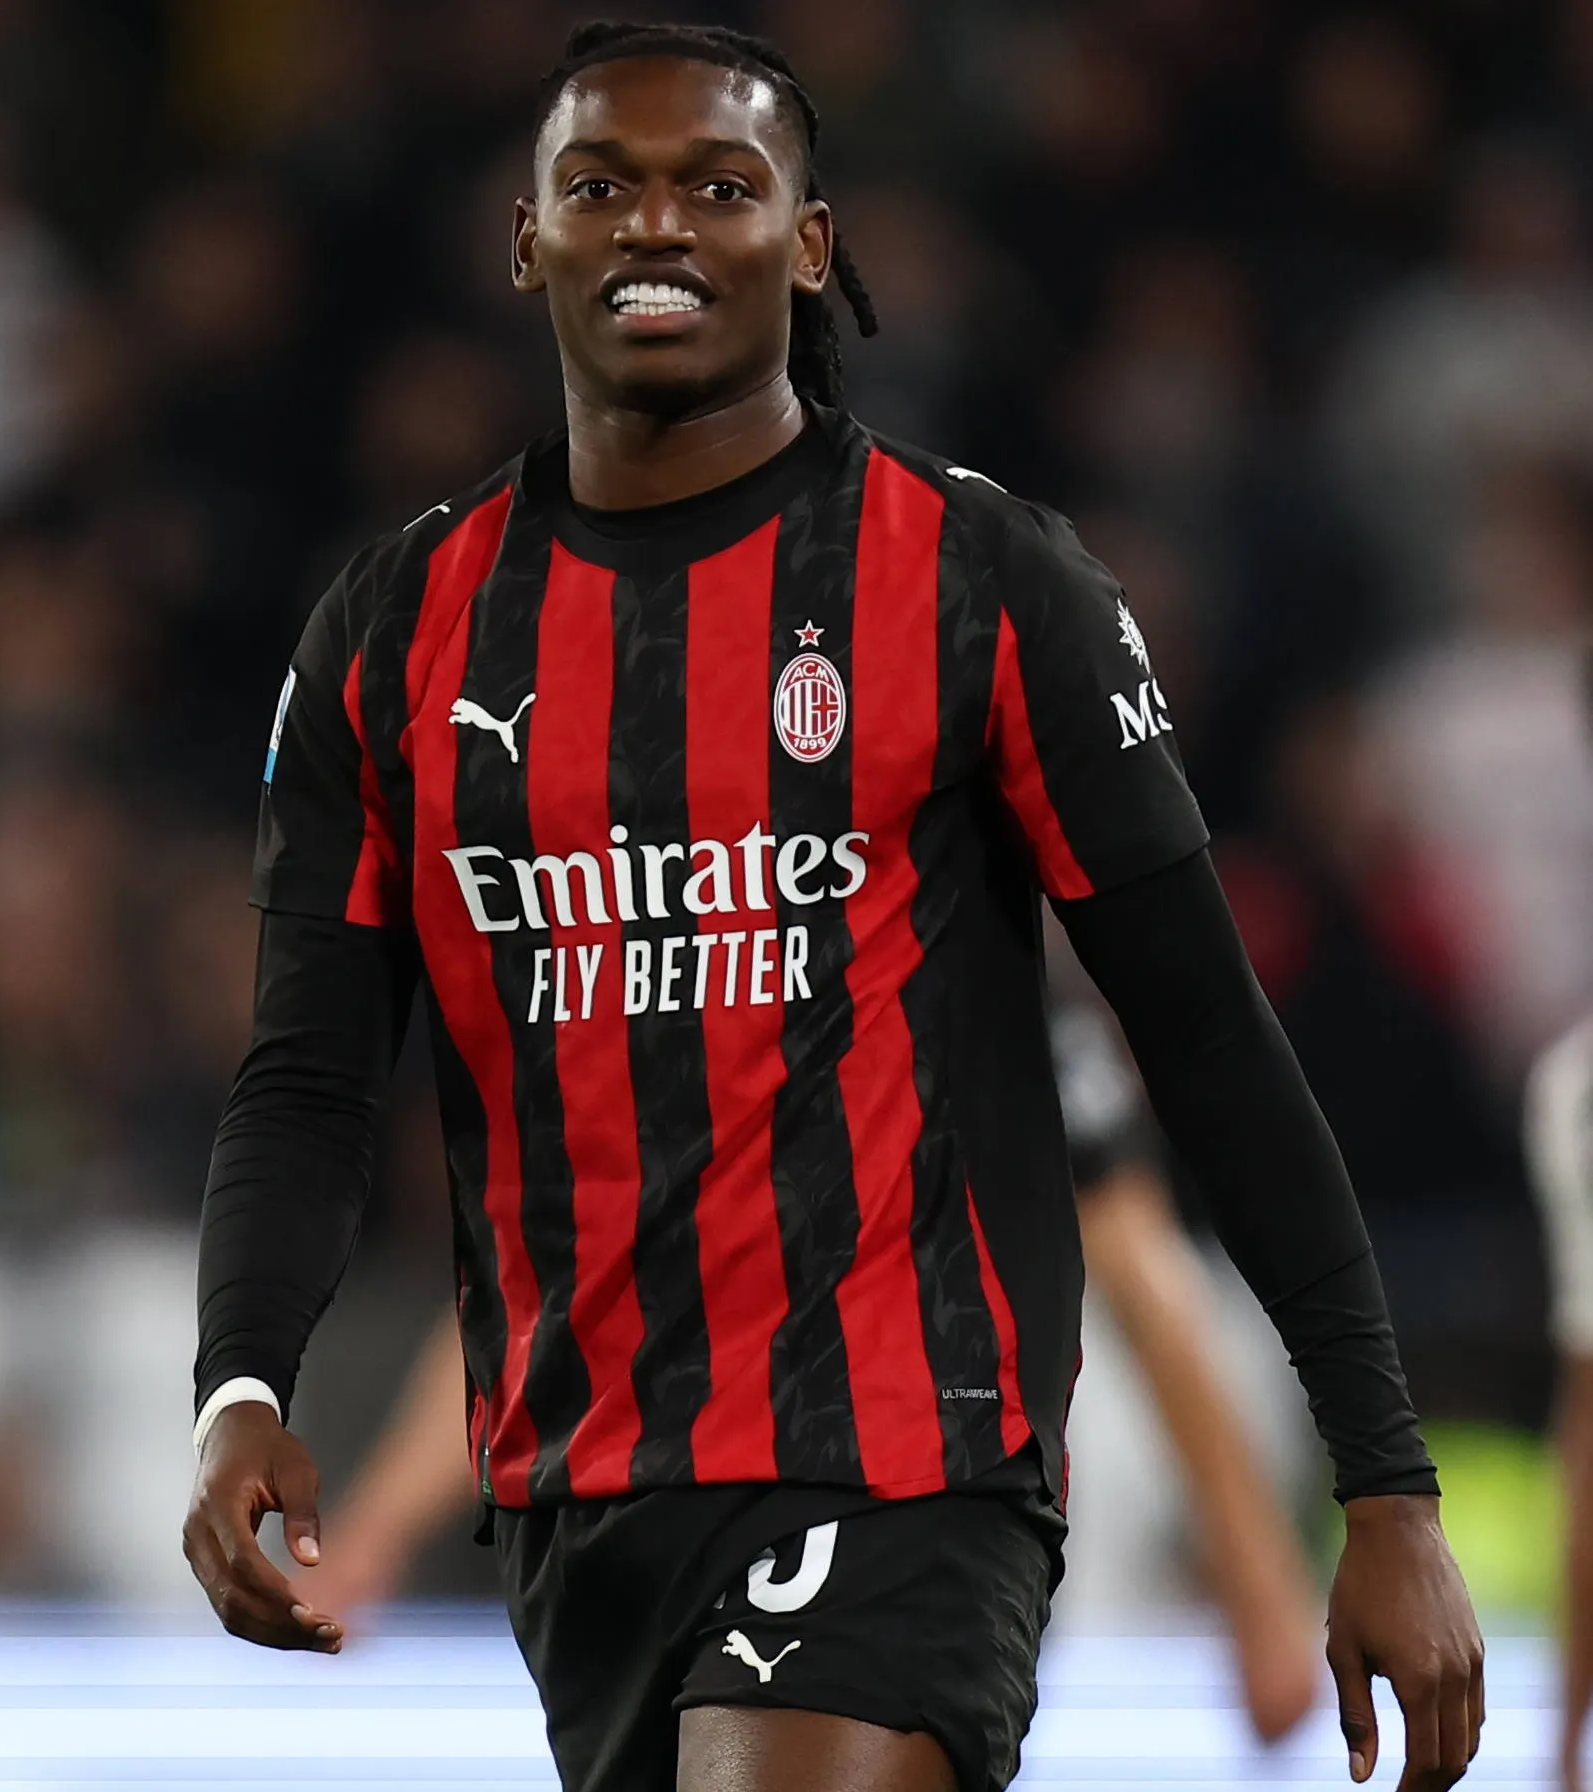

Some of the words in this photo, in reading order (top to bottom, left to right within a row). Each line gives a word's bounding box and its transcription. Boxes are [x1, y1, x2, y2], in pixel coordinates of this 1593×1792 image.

[790, 662, 830, 683] ACM
[793, 737, 827, 750] 1899
[441, 820, 870, 932] Emirates
[527, 943, 604, 1023] FLY
[623, 925, 813, 1016] BETTER
[941, 1388, 999, 1400] ULTRAWEAVE
